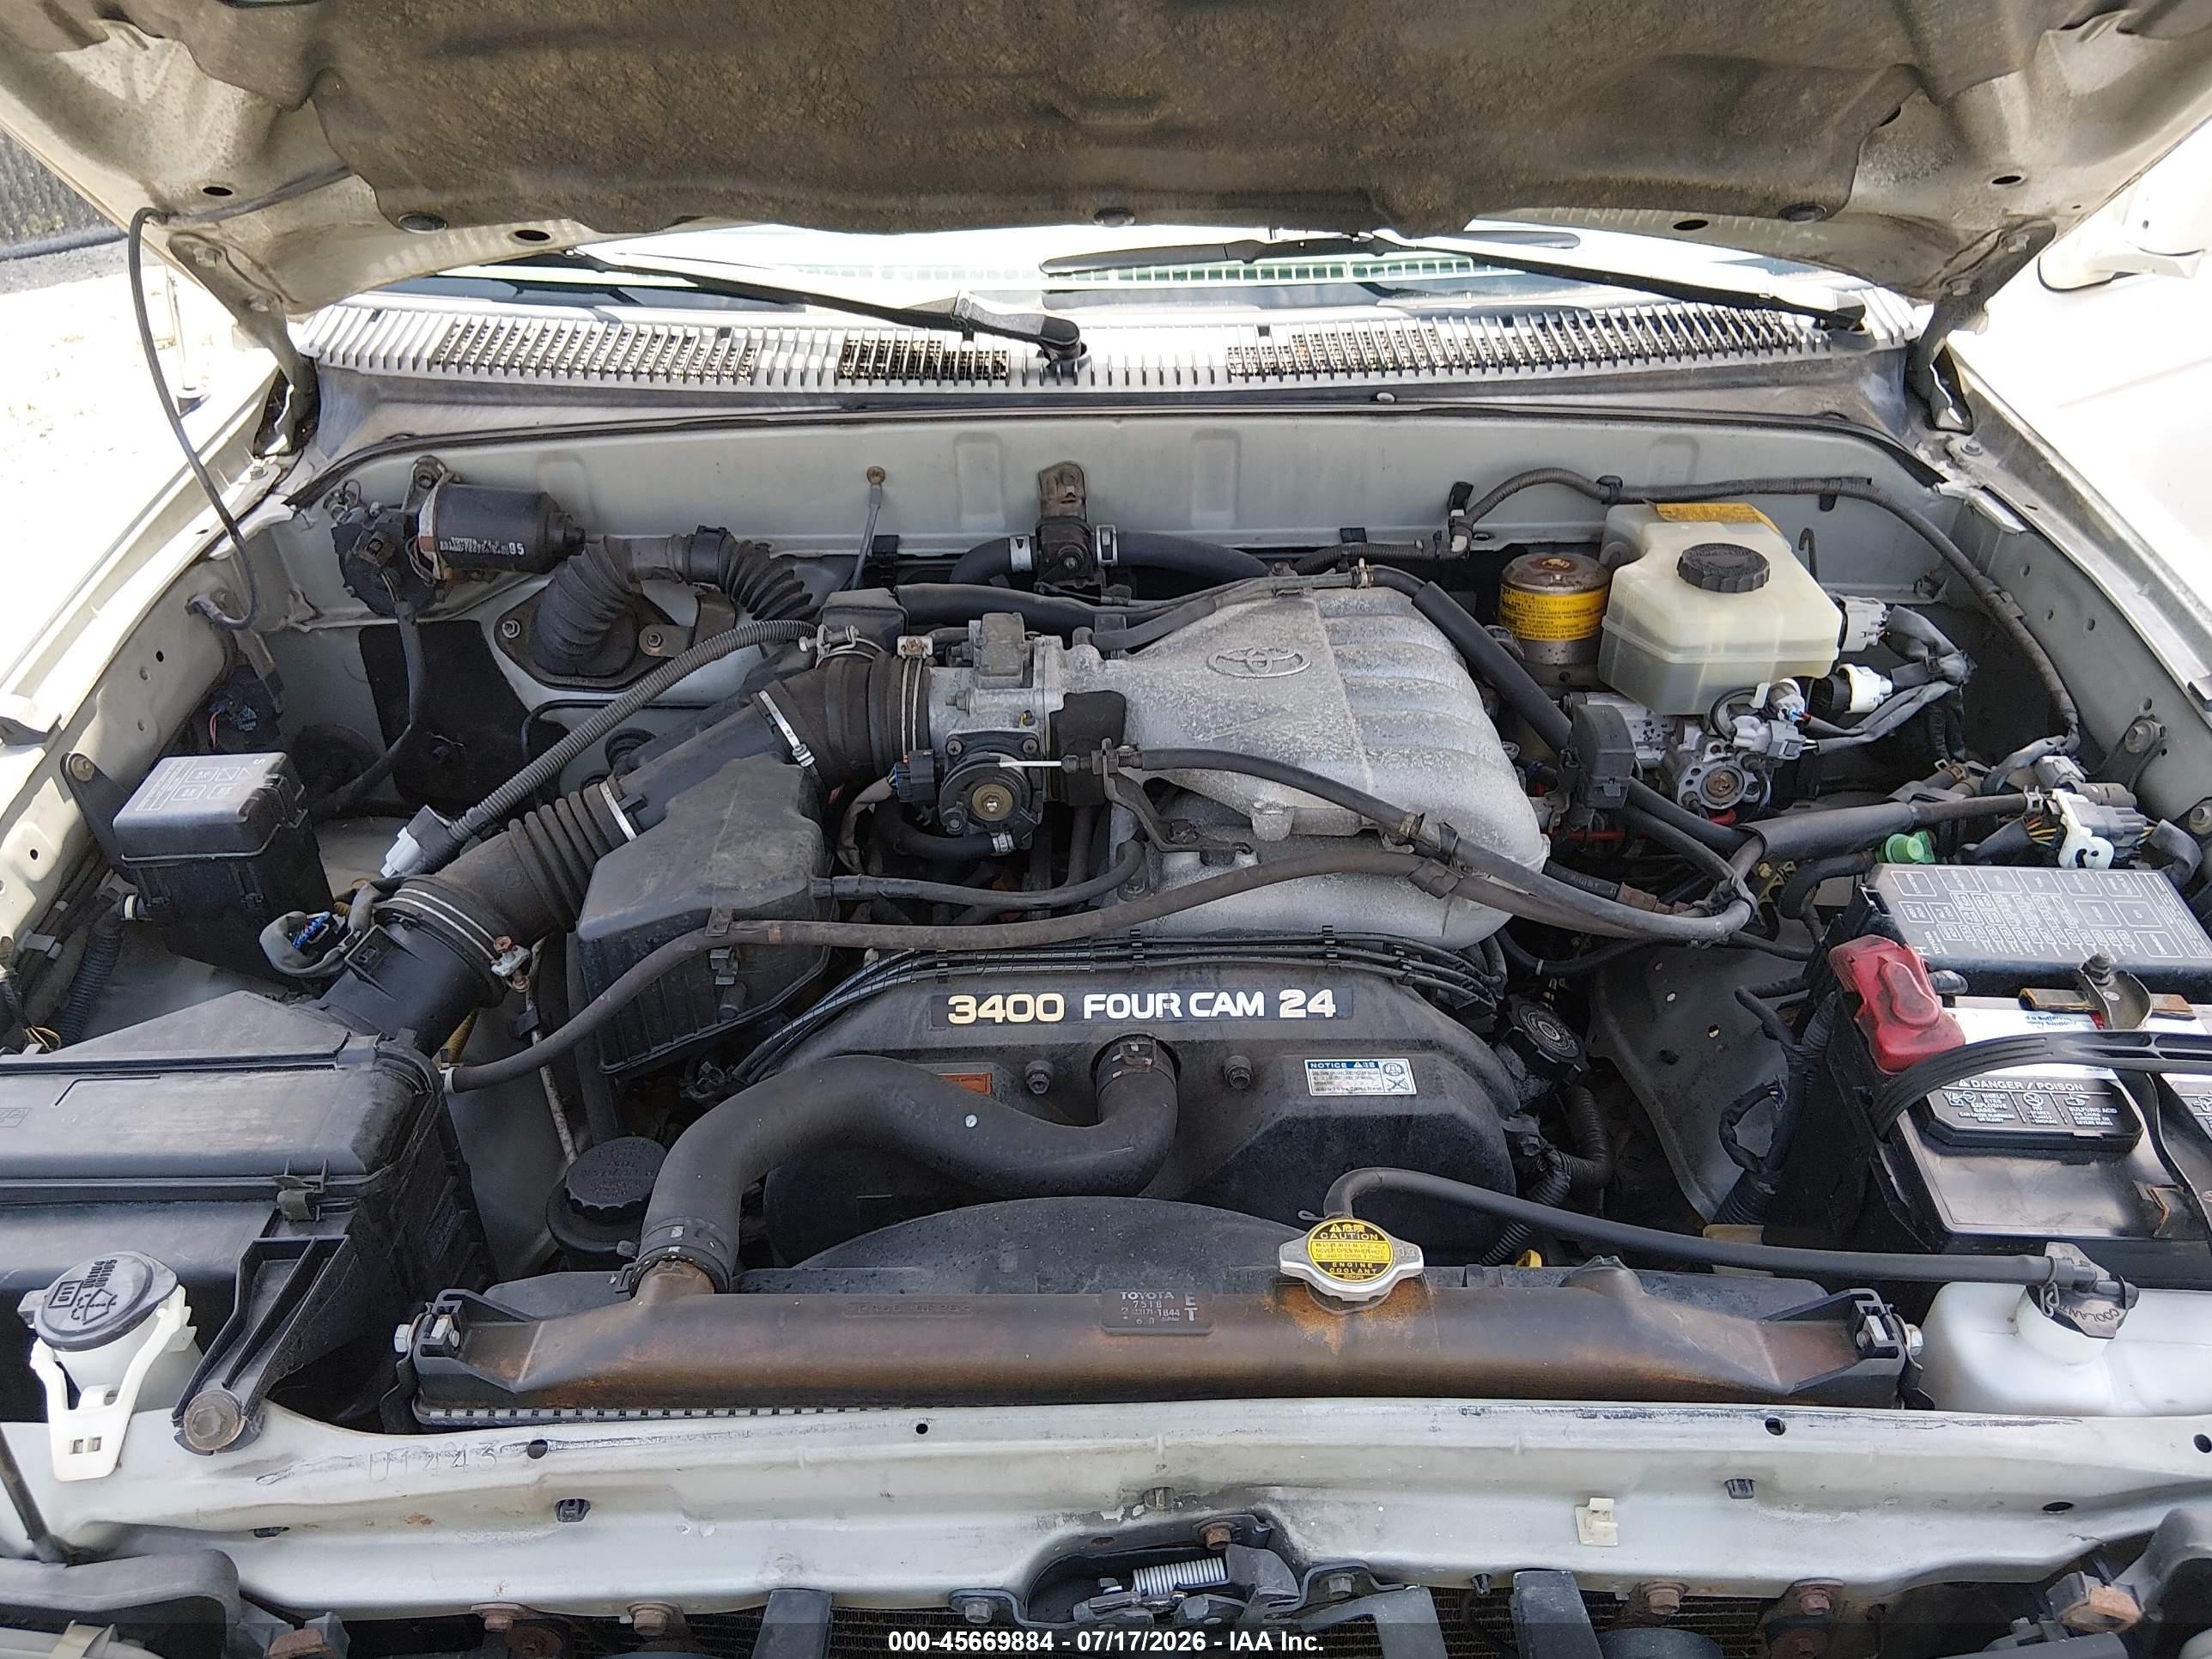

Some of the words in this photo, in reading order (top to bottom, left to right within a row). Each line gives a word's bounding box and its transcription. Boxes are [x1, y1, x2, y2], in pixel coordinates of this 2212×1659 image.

[947, 993, 1065, 1024] 3400
[1083, 992, 1181, 1019] FOUR
[1188, 991, 1265, 1018] CAM
[1279, 989, 1336, 1018] 24
[1970, 1079, 2024, 1090] DANGER
[2036, 1082, 2085, 1091] POISON
[1341, 1224, 1365, 1233] 危険
[1120, 1291, 1175, 1300] TOYOTA
[1185, 1291, 1196, 1306] E
[1184, 1307, 1198, 1322] T
[2062, 1304, 2120, 1322] COOLANT
